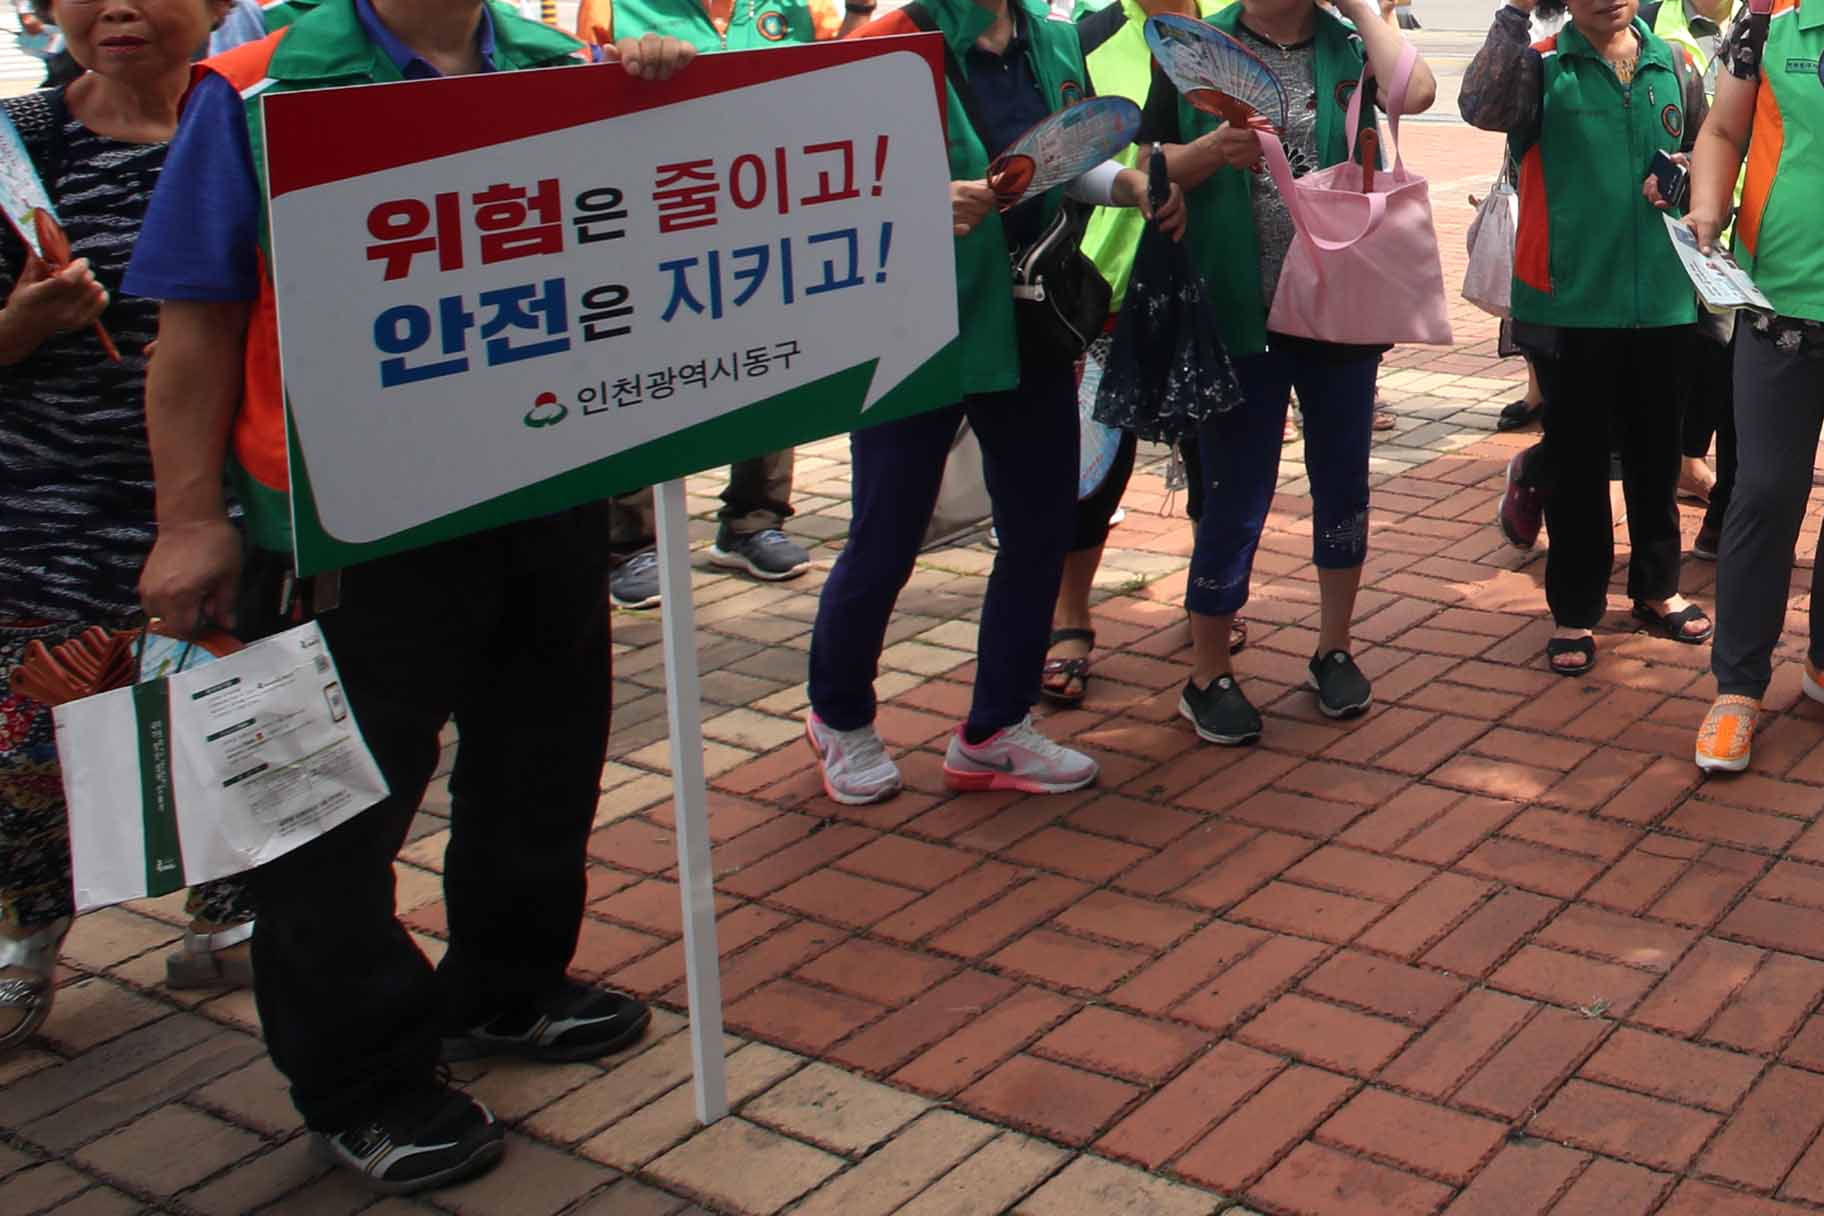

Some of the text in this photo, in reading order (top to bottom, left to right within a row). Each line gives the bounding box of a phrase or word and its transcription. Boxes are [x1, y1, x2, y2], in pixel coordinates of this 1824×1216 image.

[365, 134, 890, 282] 위험은 줄이고!
[373, 221, 895, 388] 안전은 지키고!
[576, 339, 802, 416] 인천광역시동구
